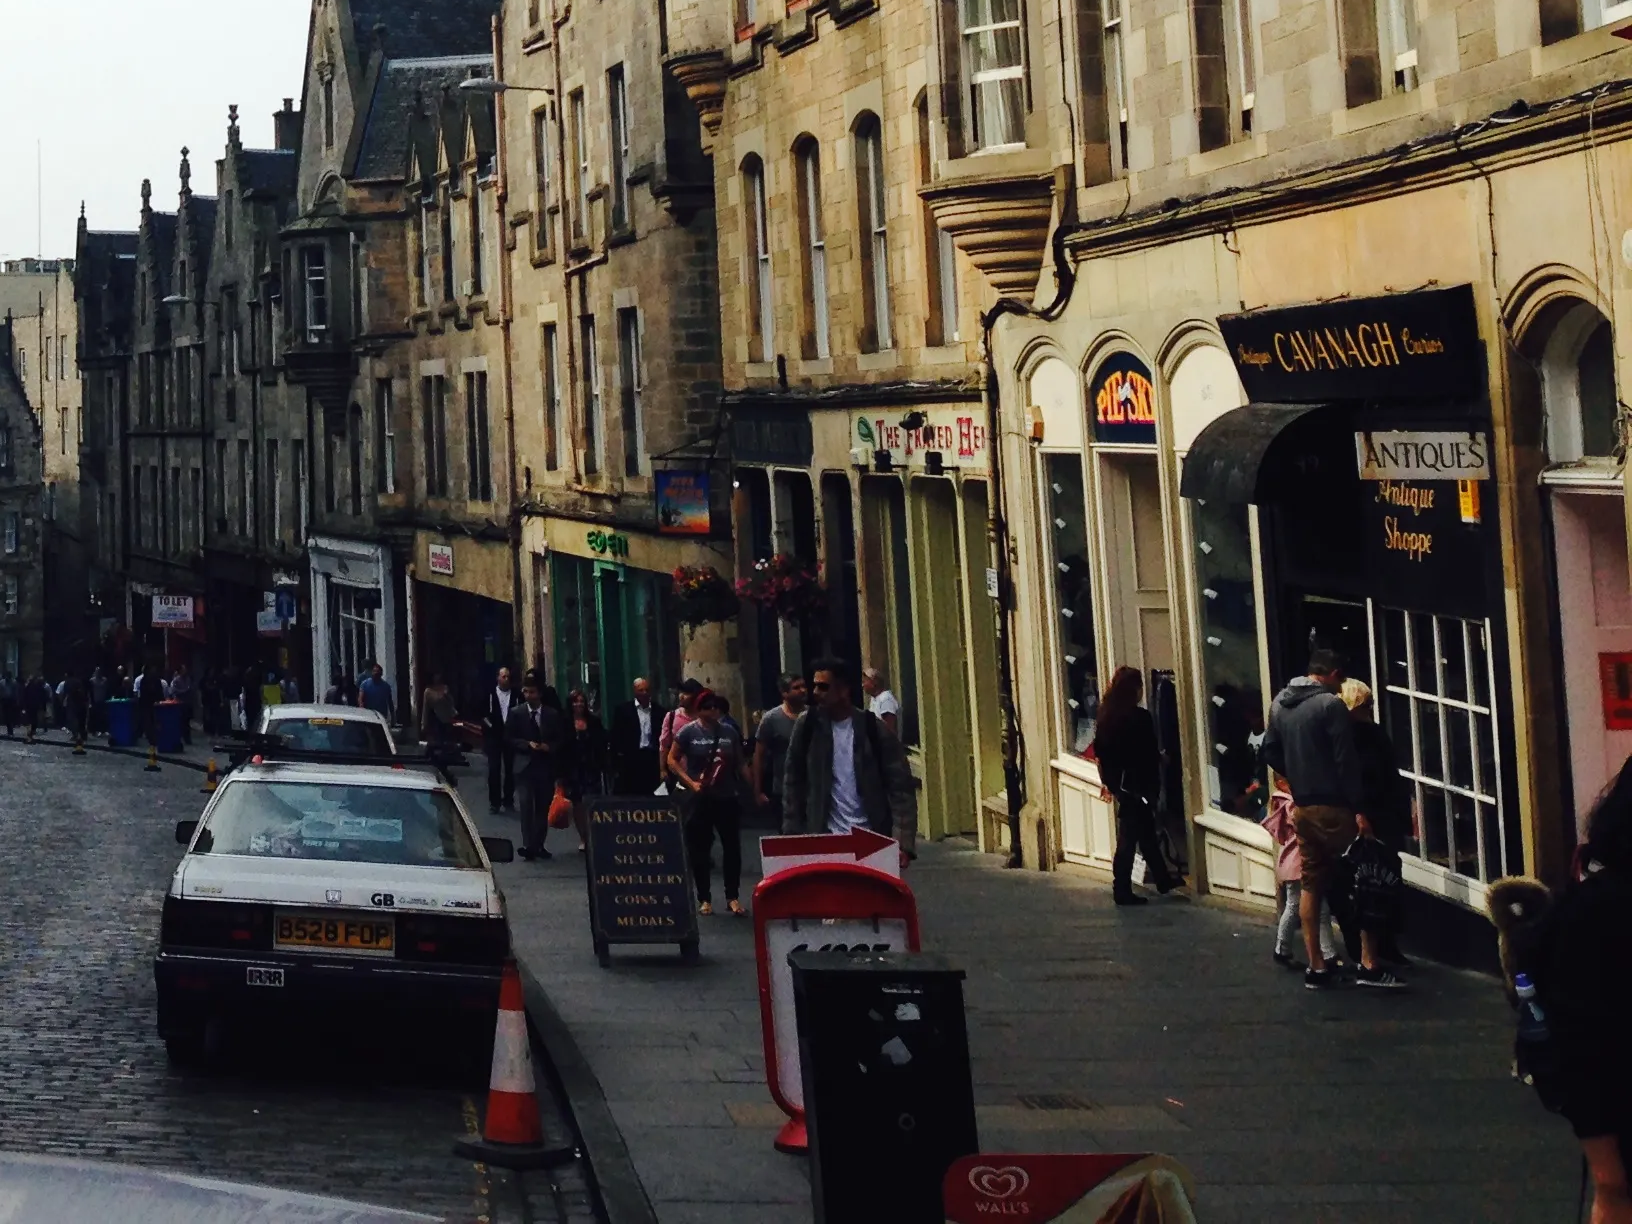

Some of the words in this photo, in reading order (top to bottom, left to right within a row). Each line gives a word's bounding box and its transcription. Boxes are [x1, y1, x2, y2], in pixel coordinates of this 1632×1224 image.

[1273, 321, 1401, 373] CAVANAGH
[1400, 327, 1445, 356] Curios
[1096, 370, 1125, 424] PIE
[875, 419, 900, 449] THE
[1365, 439, 1485, 473] ANTIQUES
[1374, 478, 1436, 516] Antique
[1385, 515, 1433, 563] Shoppe
[158, 596, 170, 607] TO
[172, 596, 188, 607] LET
[592, 809, 678, 825] ANTIQUES
[615, 834, 658, 845] GOLD
[613, 854, 665, 866] SILVER
[597, 874, 684, 885] JEWELLERY
[371, 892, 395, 907] GB
[614, 894, 658, 905] COINS
[662, 895, 672, 905] &
[616, 915, 676, 927] MEDALS
[279, 919, 338, 942] B528
[974, 1201, 1030, 1215] WALL'S
